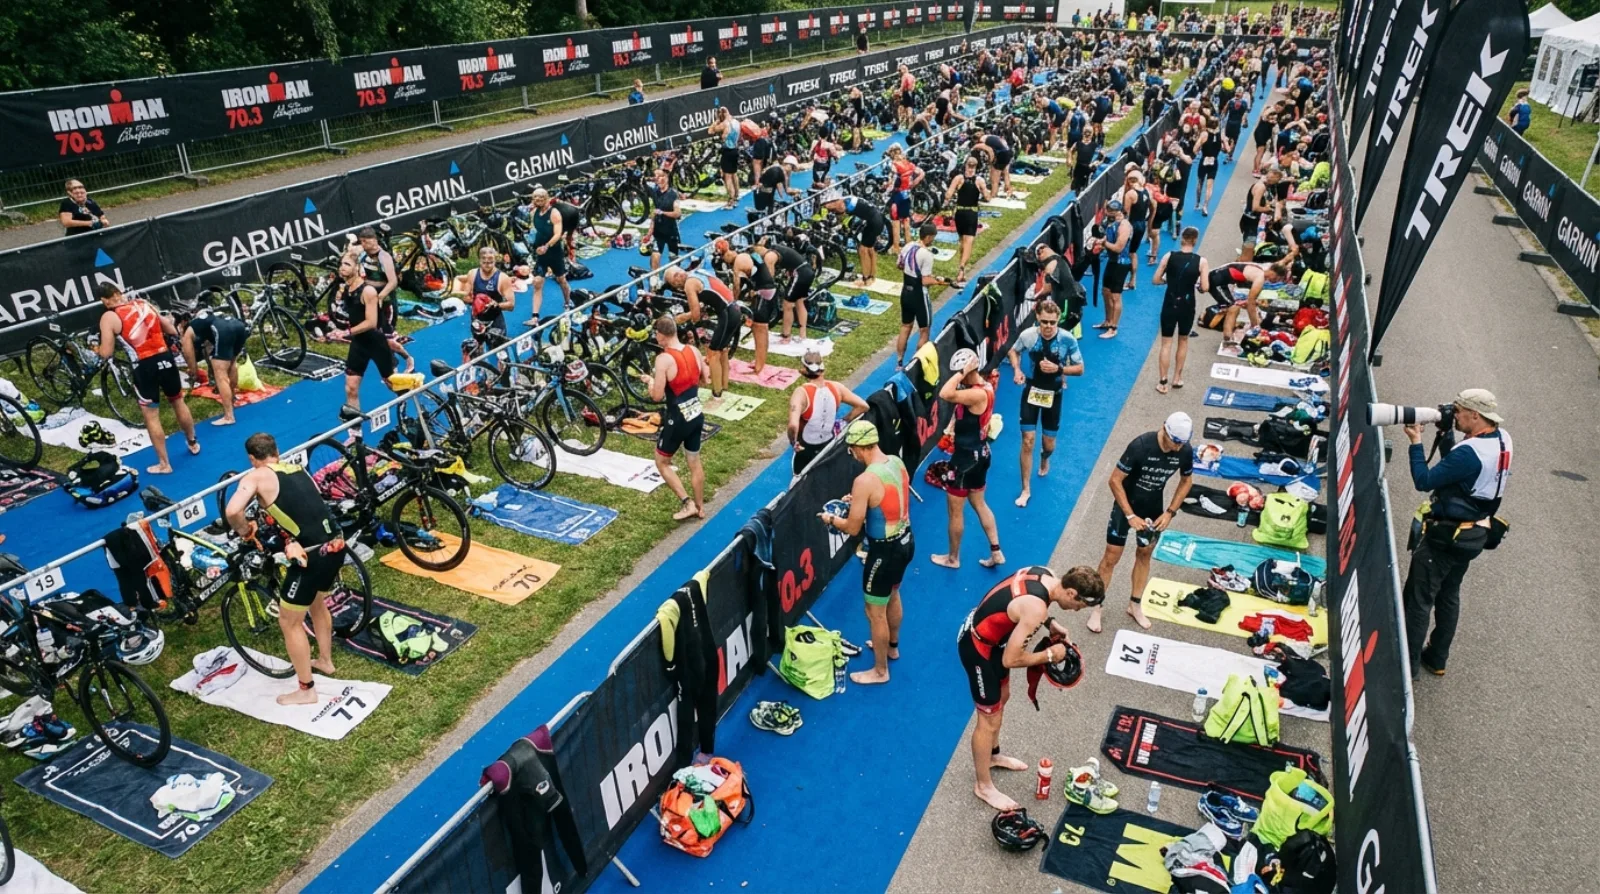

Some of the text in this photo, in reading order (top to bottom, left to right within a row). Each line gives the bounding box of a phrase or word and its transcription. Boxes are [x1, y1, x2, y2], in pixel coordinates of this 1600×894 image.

[221, 72, 313, 109] IRONMAN
[47, 92, 169, 133] IRONMAN
[226, 106, 264, 129] 70.3
[55, 129, 106, 156] 70.3
[603, 123, 659, 152] GARMIN
[1404, 33, 1510, 241] TREK
[505, 146, 575, 181] GARMIN
[376, 175, 467, 217] GARMIN
[202, 213, 327, 267] GARMIN
[1557, 216, 1600, 273] GARMIN
[513, 573, 541, 590] 70
[778, 547, 816, 614] 0.3
[1148, 589, 1171, 607] 23
[1119, 643, 1144, 665] 24
[331, 696, 367, 721] 77
